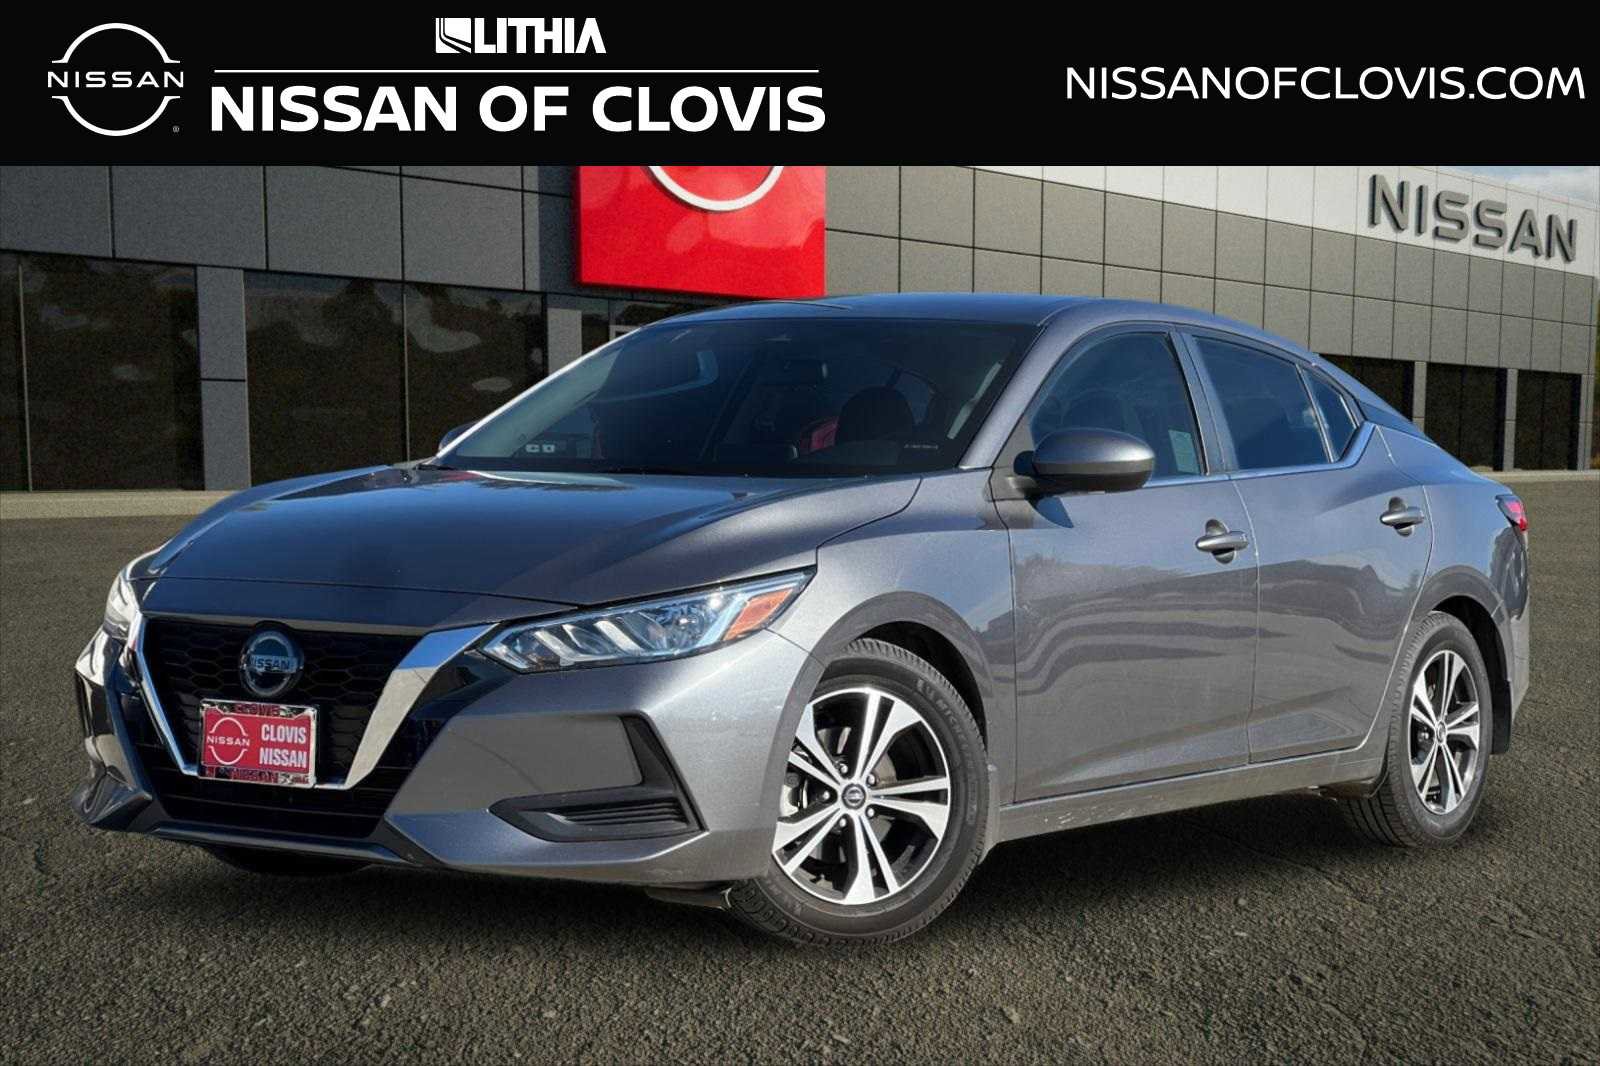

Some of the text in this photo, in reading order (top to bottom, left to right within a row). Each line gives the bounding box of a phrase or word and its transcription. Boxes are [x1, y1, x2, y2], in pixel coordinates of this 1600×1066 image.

[1368, 174, 1577, 263] NISSAN
[206, 735, 251, 747] NISSAN
[261, 723, 307, 744] CLOVIS
[259, 747, 308, 768] NISSAN
